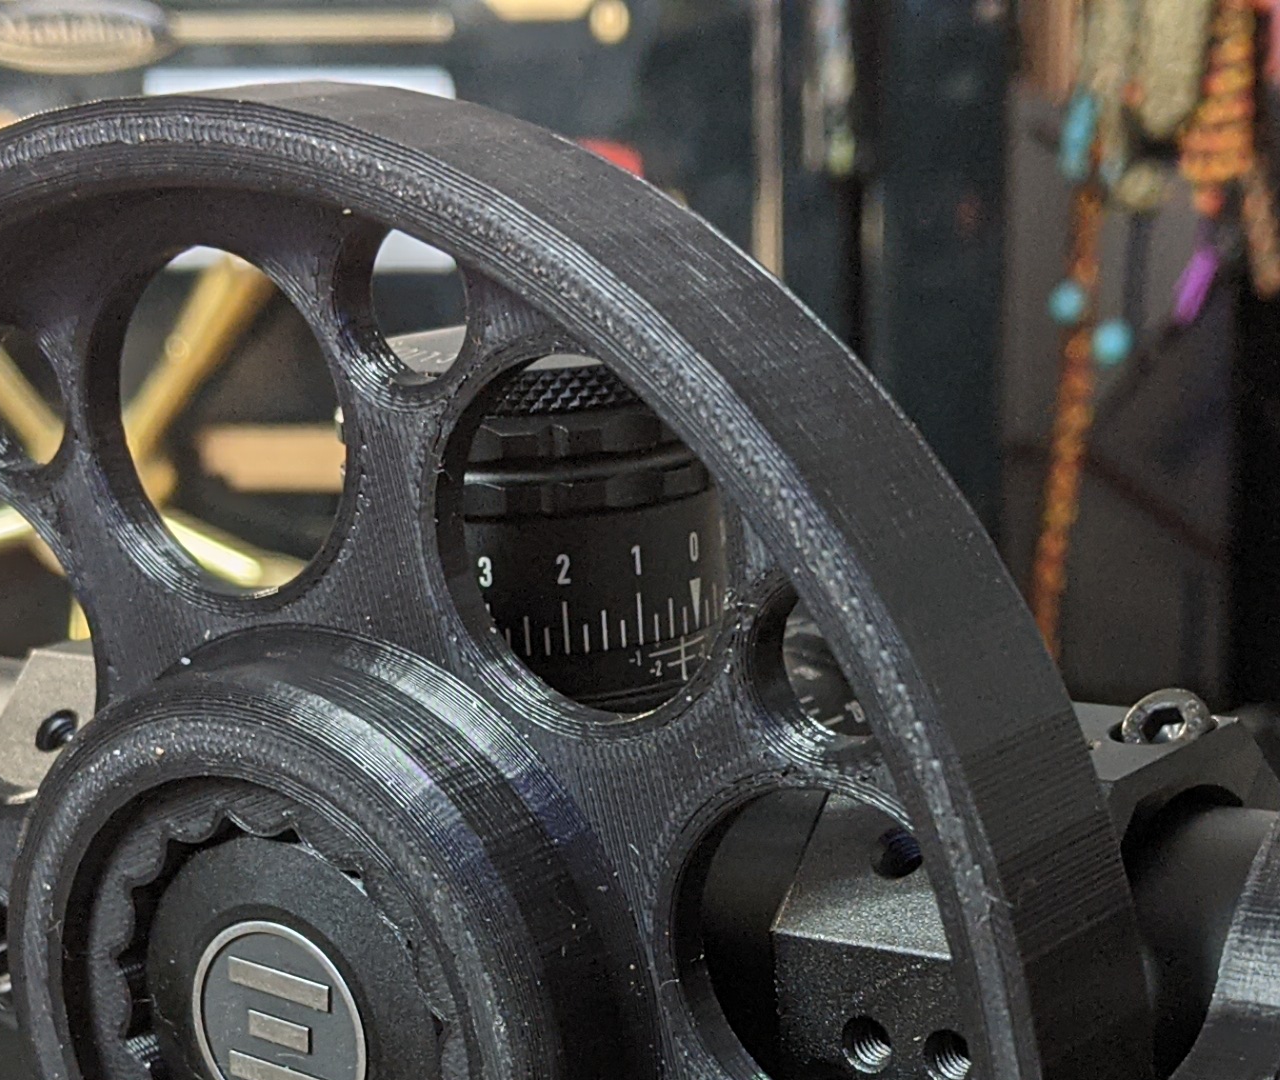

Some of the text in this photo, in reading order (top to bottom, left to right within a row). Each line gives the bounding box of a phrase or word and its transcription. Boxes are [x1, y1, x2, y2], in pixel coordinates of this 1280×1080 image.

[478, 532, 699, 587] 3 2 1 0
